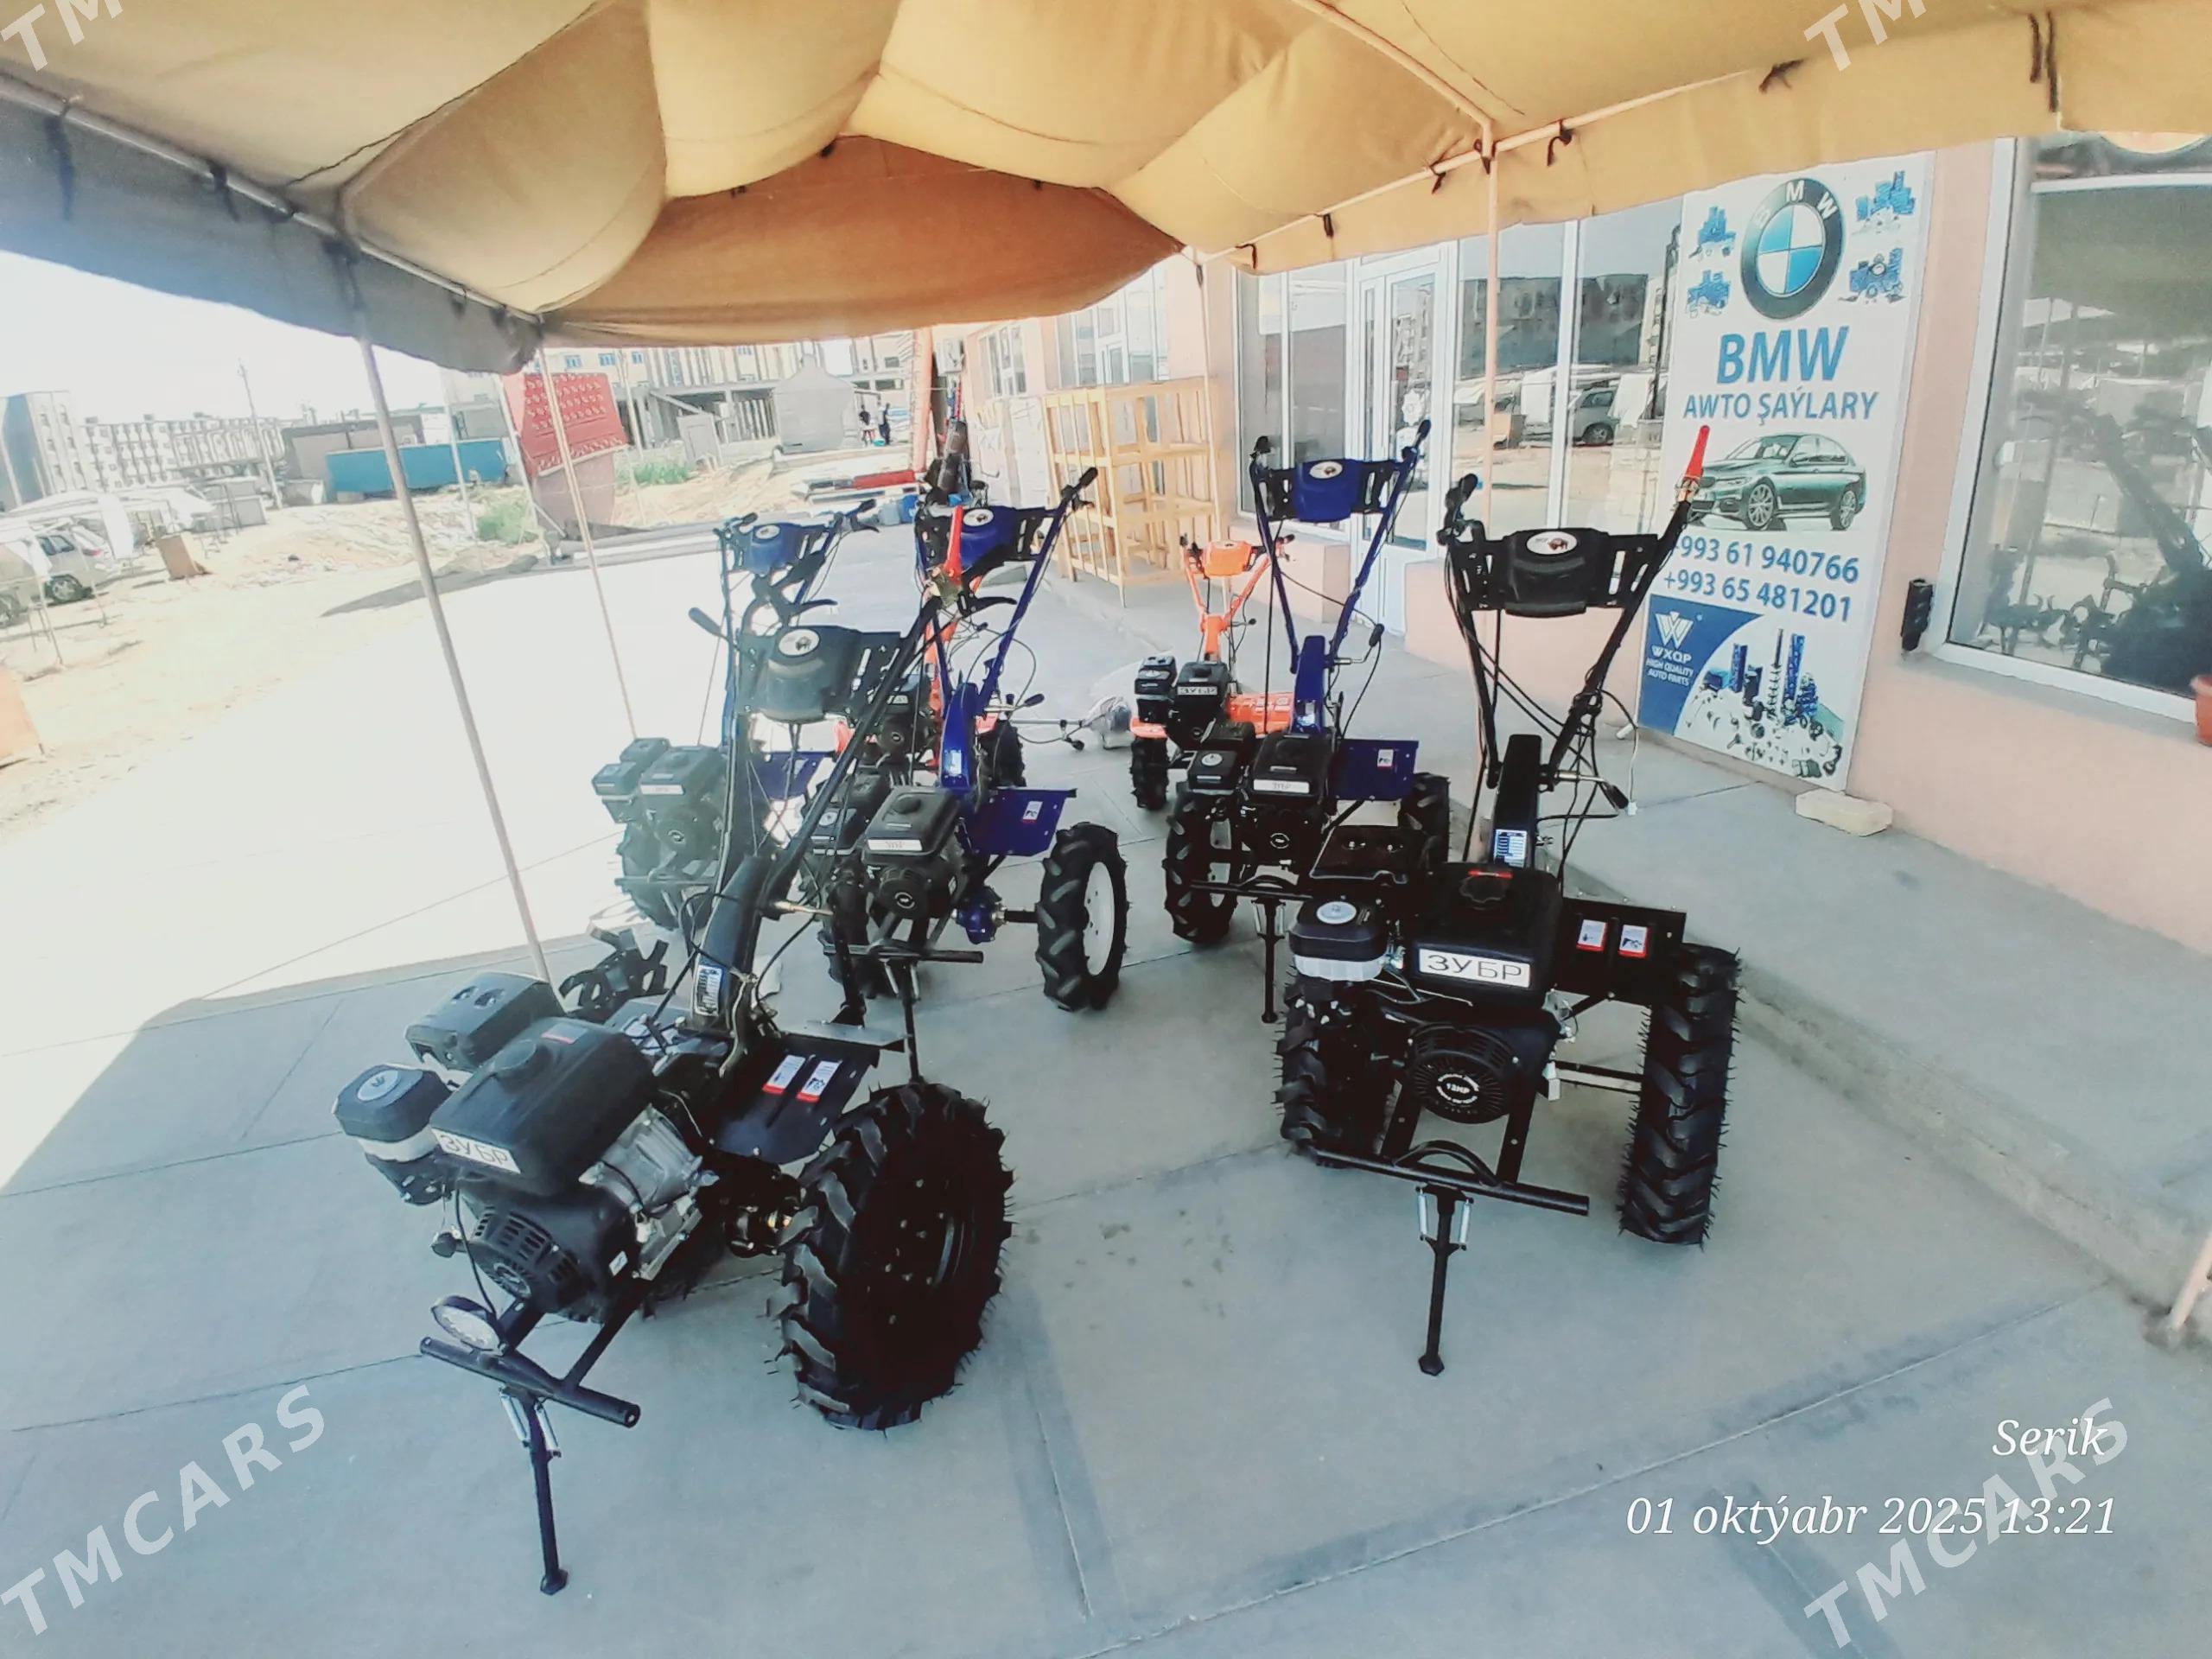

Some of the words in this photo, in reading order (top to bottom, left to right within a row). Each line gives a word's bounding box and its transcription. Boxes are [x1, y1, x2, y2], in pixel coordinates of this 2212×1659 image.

[1753, 180, 1839, 229] BMW
[1716, 326, 1850, 385] BMW
[1683, 394, 1752, 419] AWTO
[1758, 387, 1879, 426] ŞAÝLARY
[1675, 536, 1719, 561] 993
[1726, 541, 1753, 567] 61
[1762, 545, 1859, 583] 940766
[1664, 569, 1715, 595] +993
[1722, 577, 1750, 602] 65
[1756, 582, 1852, 622] 481201
[1427, 955, 1522, 980] ЗУБР
[441, 1135, 508, 1166] ЗУБР
